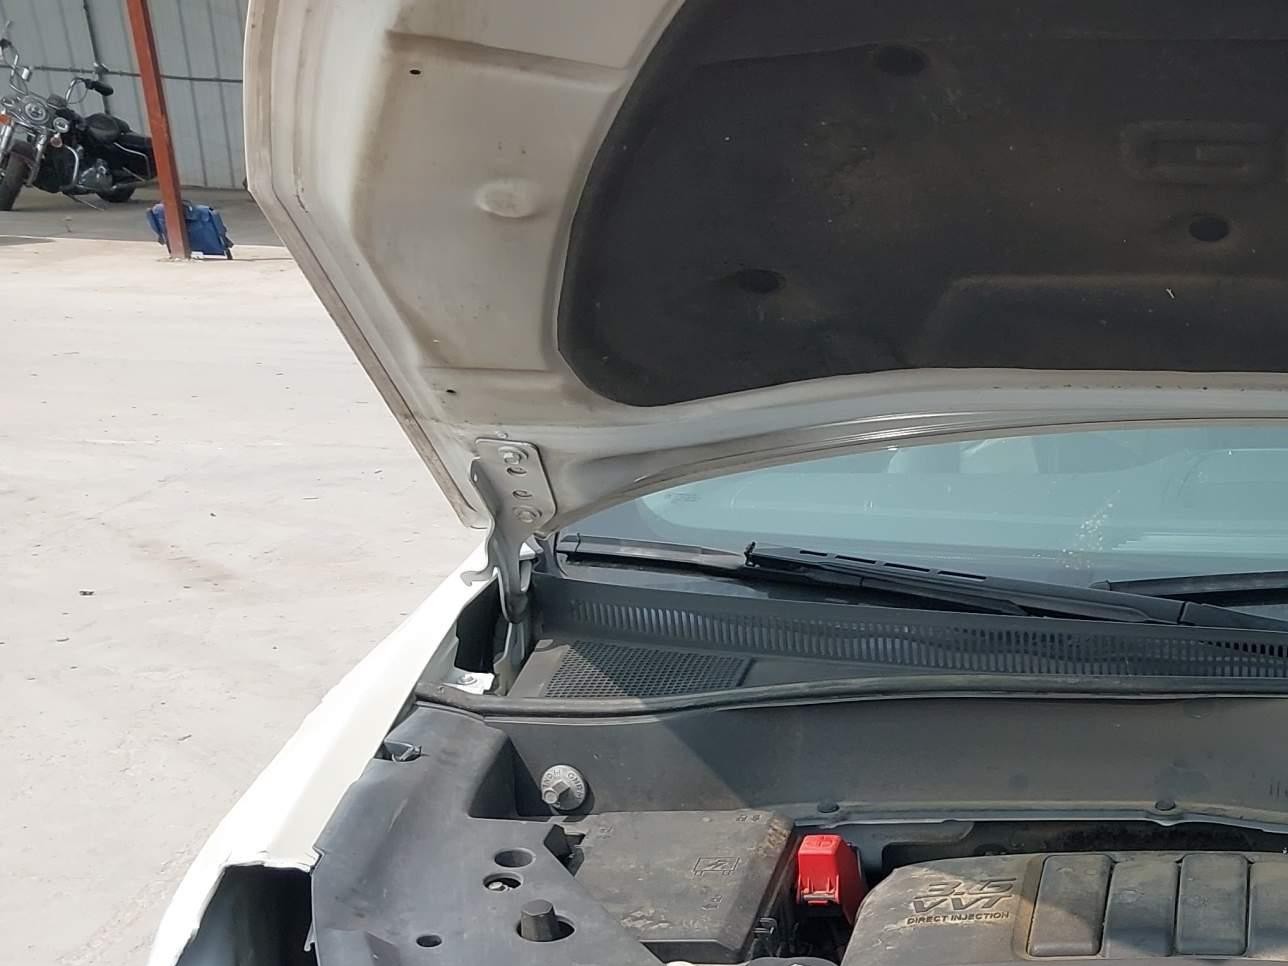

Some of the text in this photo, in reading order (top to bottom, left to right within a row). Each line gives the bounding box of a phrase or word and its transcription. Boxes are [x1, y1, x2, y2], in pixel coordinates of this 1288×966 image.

[912, 894, 1014, 914] VVT
[906, 911, 1010, 925] DIRECT INJECTION
